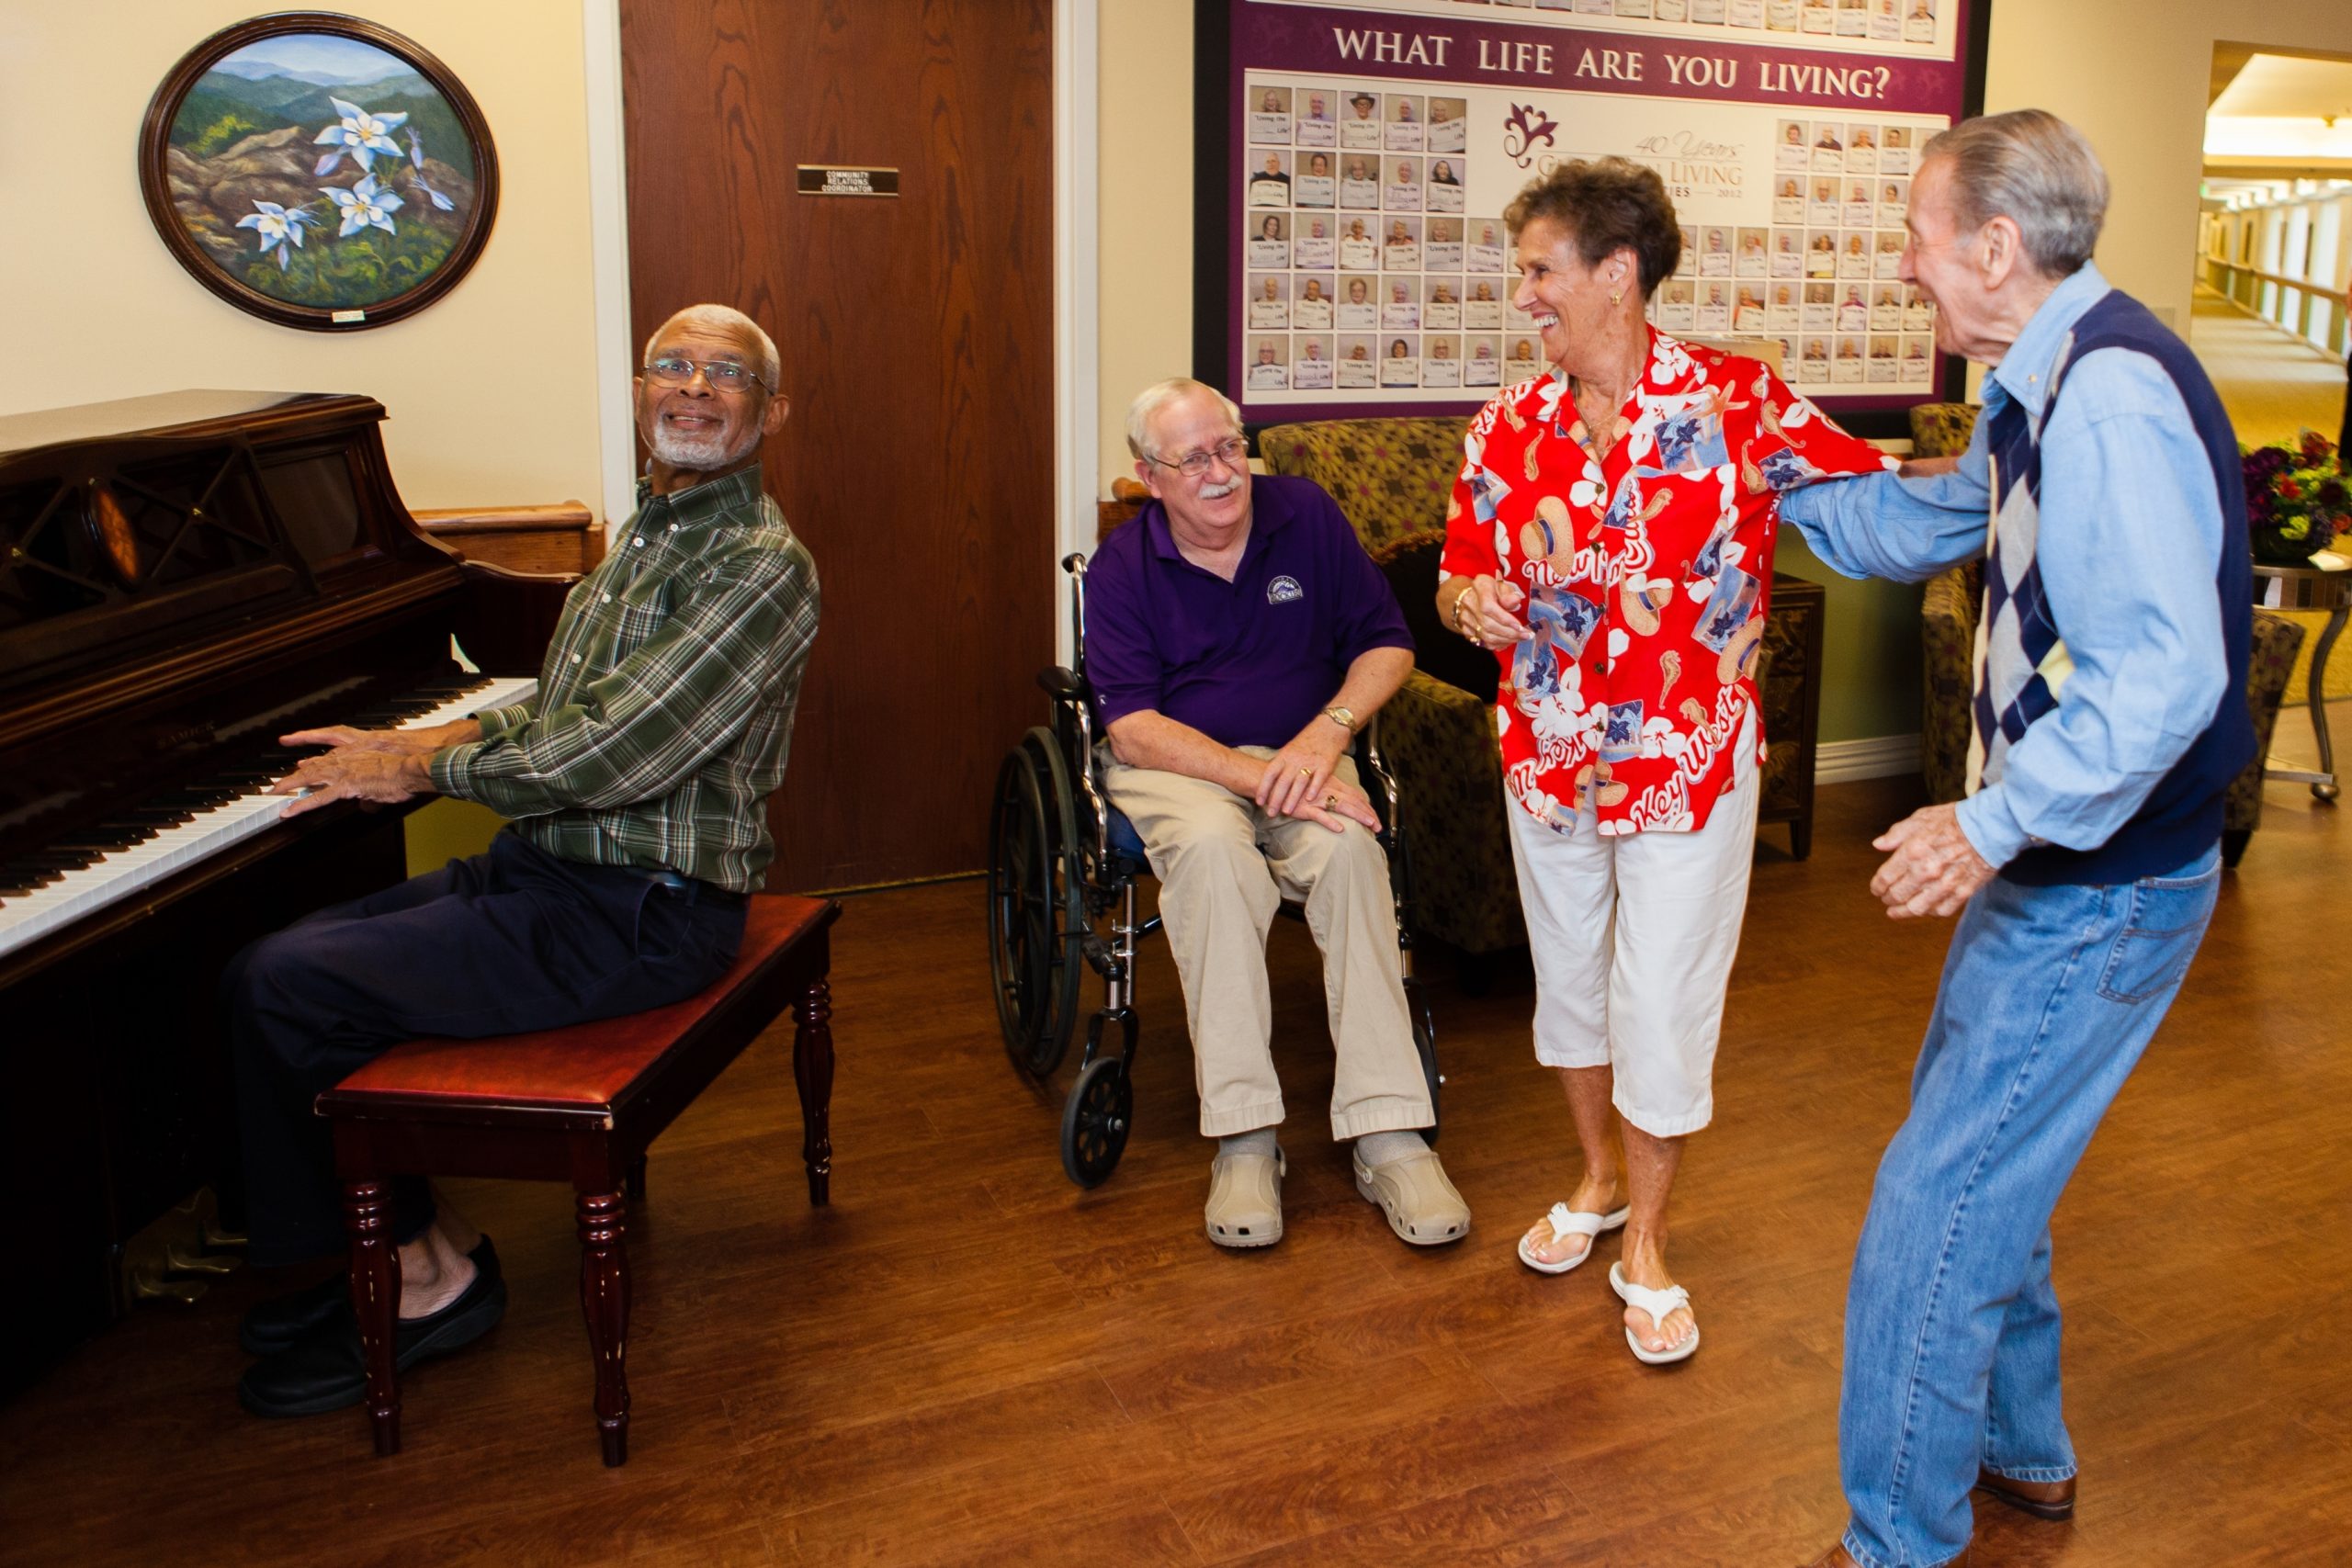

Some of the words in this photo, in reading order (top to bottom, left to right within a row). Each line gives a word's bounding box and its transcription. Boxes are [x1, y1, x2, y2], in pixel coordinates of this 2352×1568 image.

[1332, 28, 1453, 66] WHAT
[1477, 39, 1554, 74] LIFE
[1574, 48, 1644, 81] ARE
[1663, 54, 1739, 88] YOU
[1758, 62, 1891, 99] LIVING?
[1635, 136, 1668, 154] 40
[1671, 130, 1745, 164] Years
[1670, 162, 1742, 186] LIVING
[1630, 770, 1689, 829] Key
[1676, 684, 1742, 784] West
